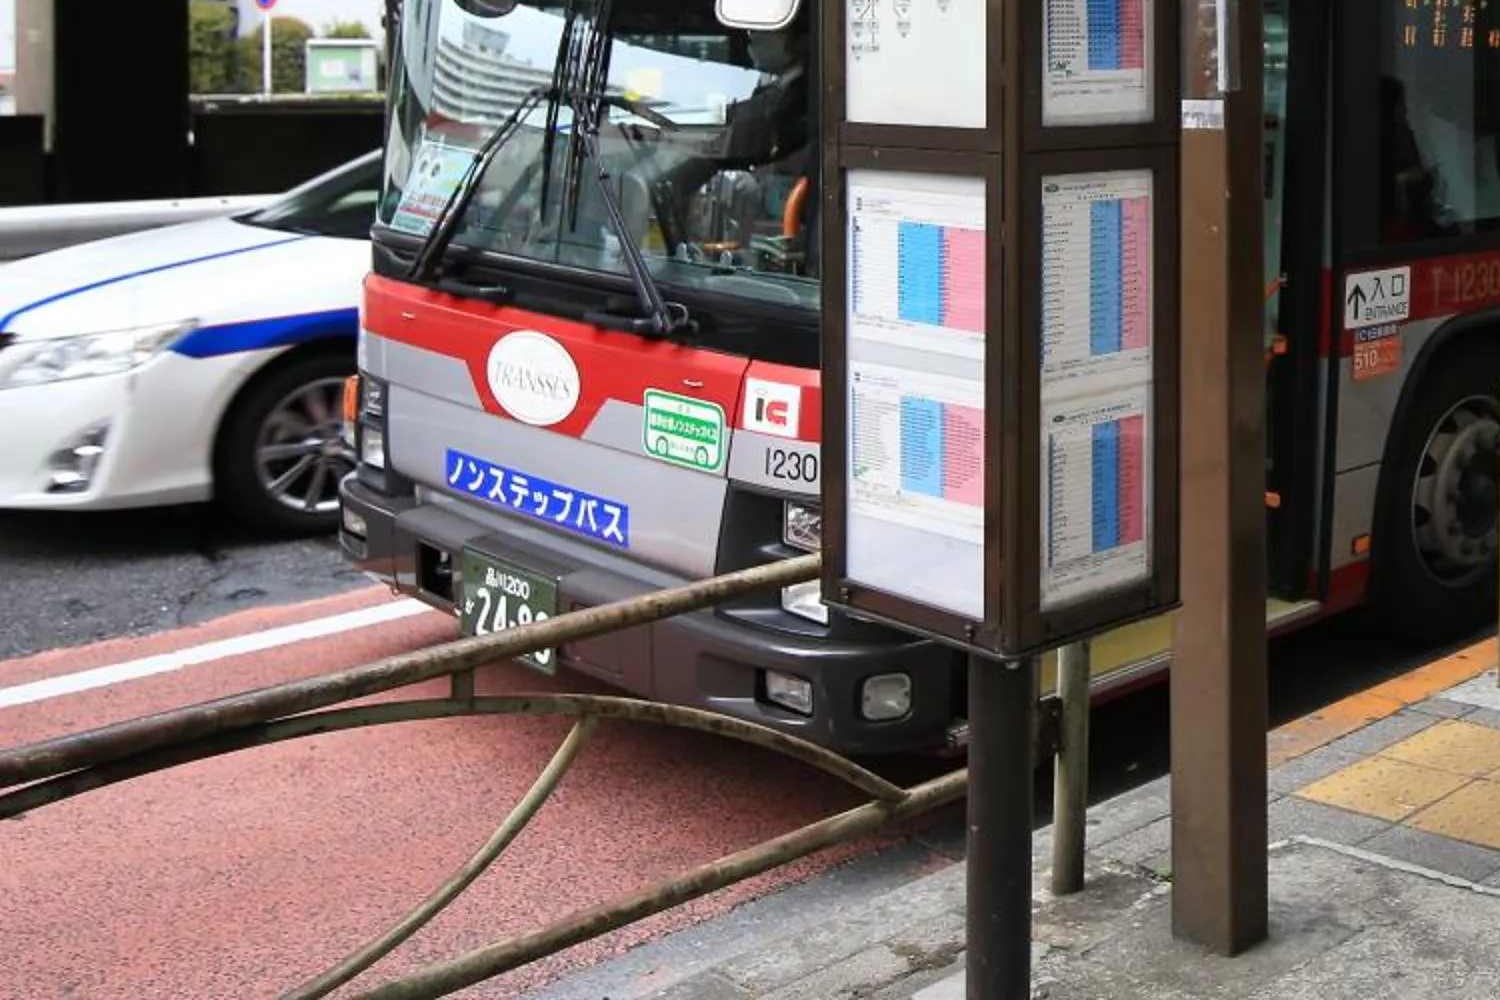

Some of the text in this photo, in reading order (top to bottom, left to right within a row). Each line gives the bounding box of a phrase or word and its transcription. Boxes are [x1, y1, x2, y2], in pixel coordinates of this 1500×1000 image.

[1371, 273, 1405, 301] 入口
[1365, 301, 1408, 321] ENTRANCE
[1354, 350, 1378, 370] 510
[765, 446, 818, 483] 1230
[450, 457, 624, 543] ノンステップバス
